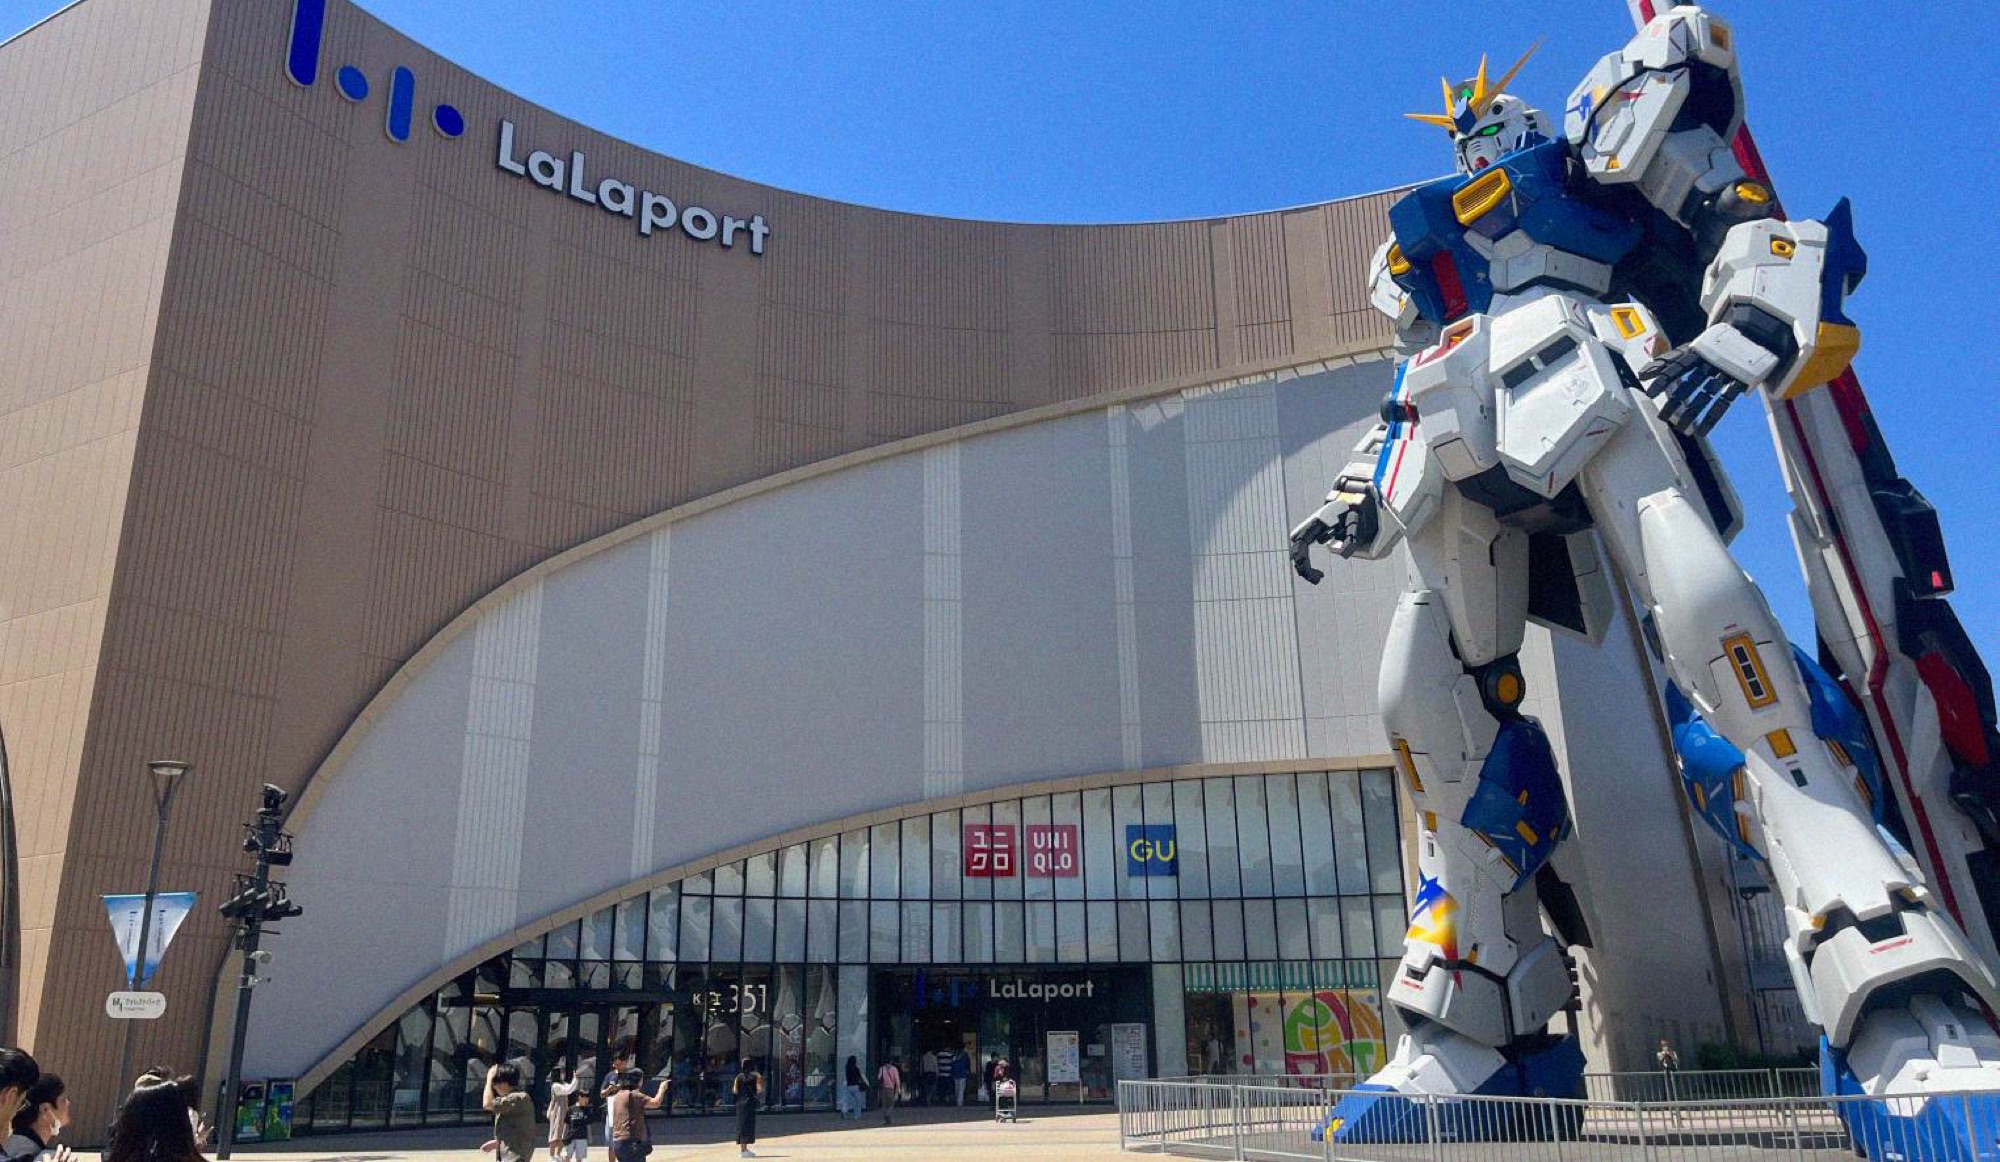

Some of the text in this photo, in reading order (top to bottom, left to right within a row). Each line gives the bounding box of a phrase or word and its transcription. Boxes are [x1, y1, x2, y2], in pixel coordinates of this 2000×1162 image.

[495, 118, 769, 254] LaLaport
[973, 831, 1009, 848] ユニ
[1033, 832, 1069, 849] UNI
[1130, 839, 1175, 862] GU
[972, 852, 1009, 871] クロ
[1033, 853, 1072, 873] QLO
[729, 984, 767, 1013] 351
[990, 978, 1094, 1003] LaLaport
